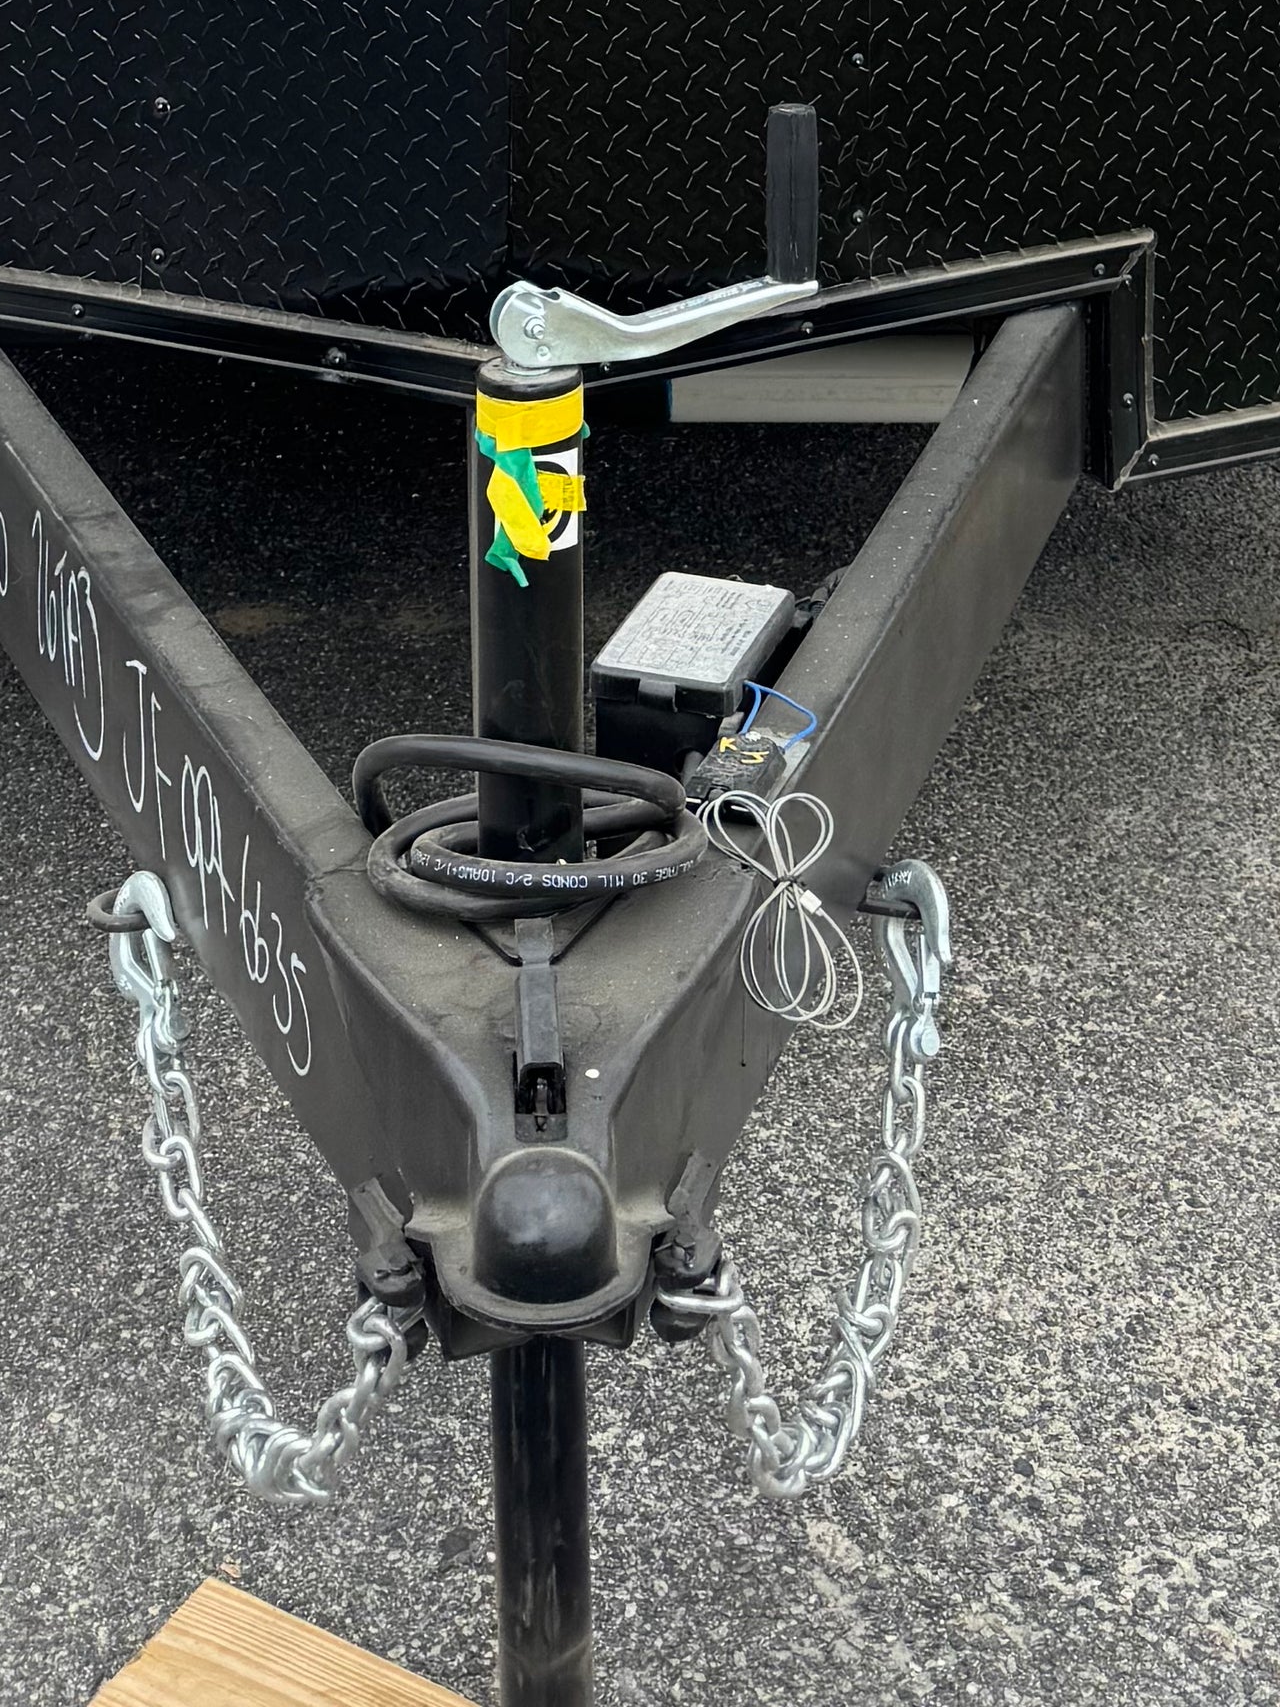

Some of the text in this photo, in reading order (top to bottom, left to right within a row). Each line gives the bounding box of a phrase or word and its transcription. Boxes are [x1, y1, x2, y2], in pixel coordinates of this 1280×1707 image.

[505, 872, 533, 886] 2/C
[541, 873, 589, 889] CONDS
[597, 873, 625, 888] MIL
[632, 871, 648, 886] 30
